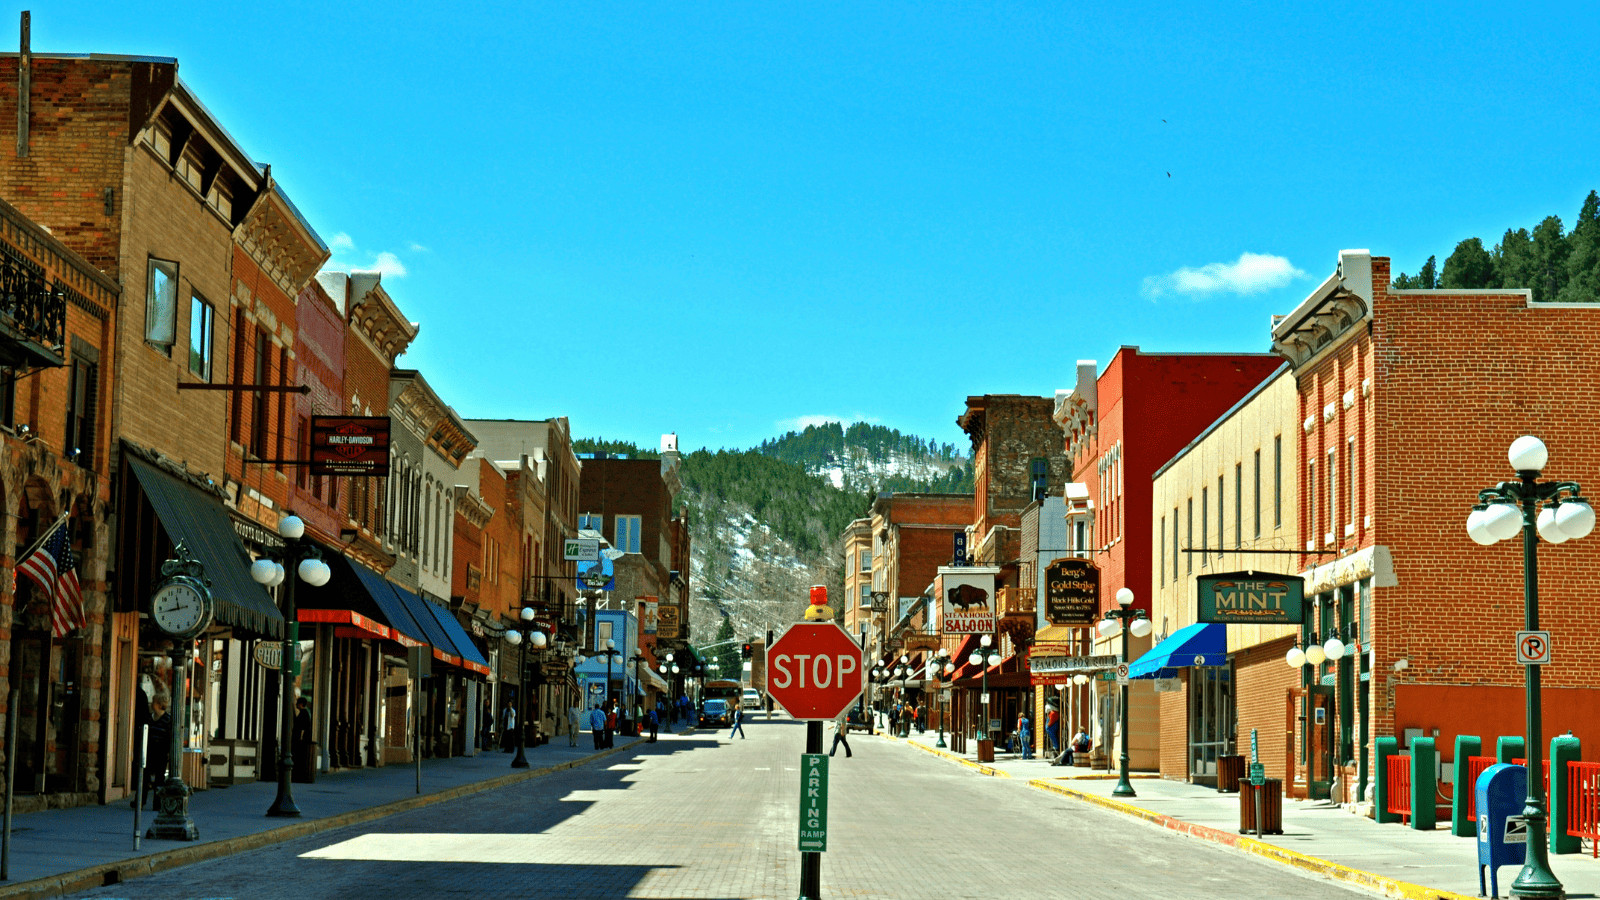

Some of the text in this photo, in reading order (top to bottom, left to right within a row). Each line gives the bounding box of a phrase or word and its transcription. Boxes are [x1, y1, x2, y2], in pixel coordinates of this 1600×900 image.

[328, 436, 374, 444] HARLEY-DAVIDSON
[1062, 568, 1085, 578] Berg's
[1051, 581, 1095, 589] Gold Strike
[1234, 582, 1265, 590] THE
[1215, 592, 1287, 609] MINT
[945, 619, 993, 632] SALOON
[1035, 660, 1068, 669] FAMOUS
[1074, 657, 1089, 667] FOR
[774, 654, 856, 689] STOP
[807, 757, 820, 828] PARKING
